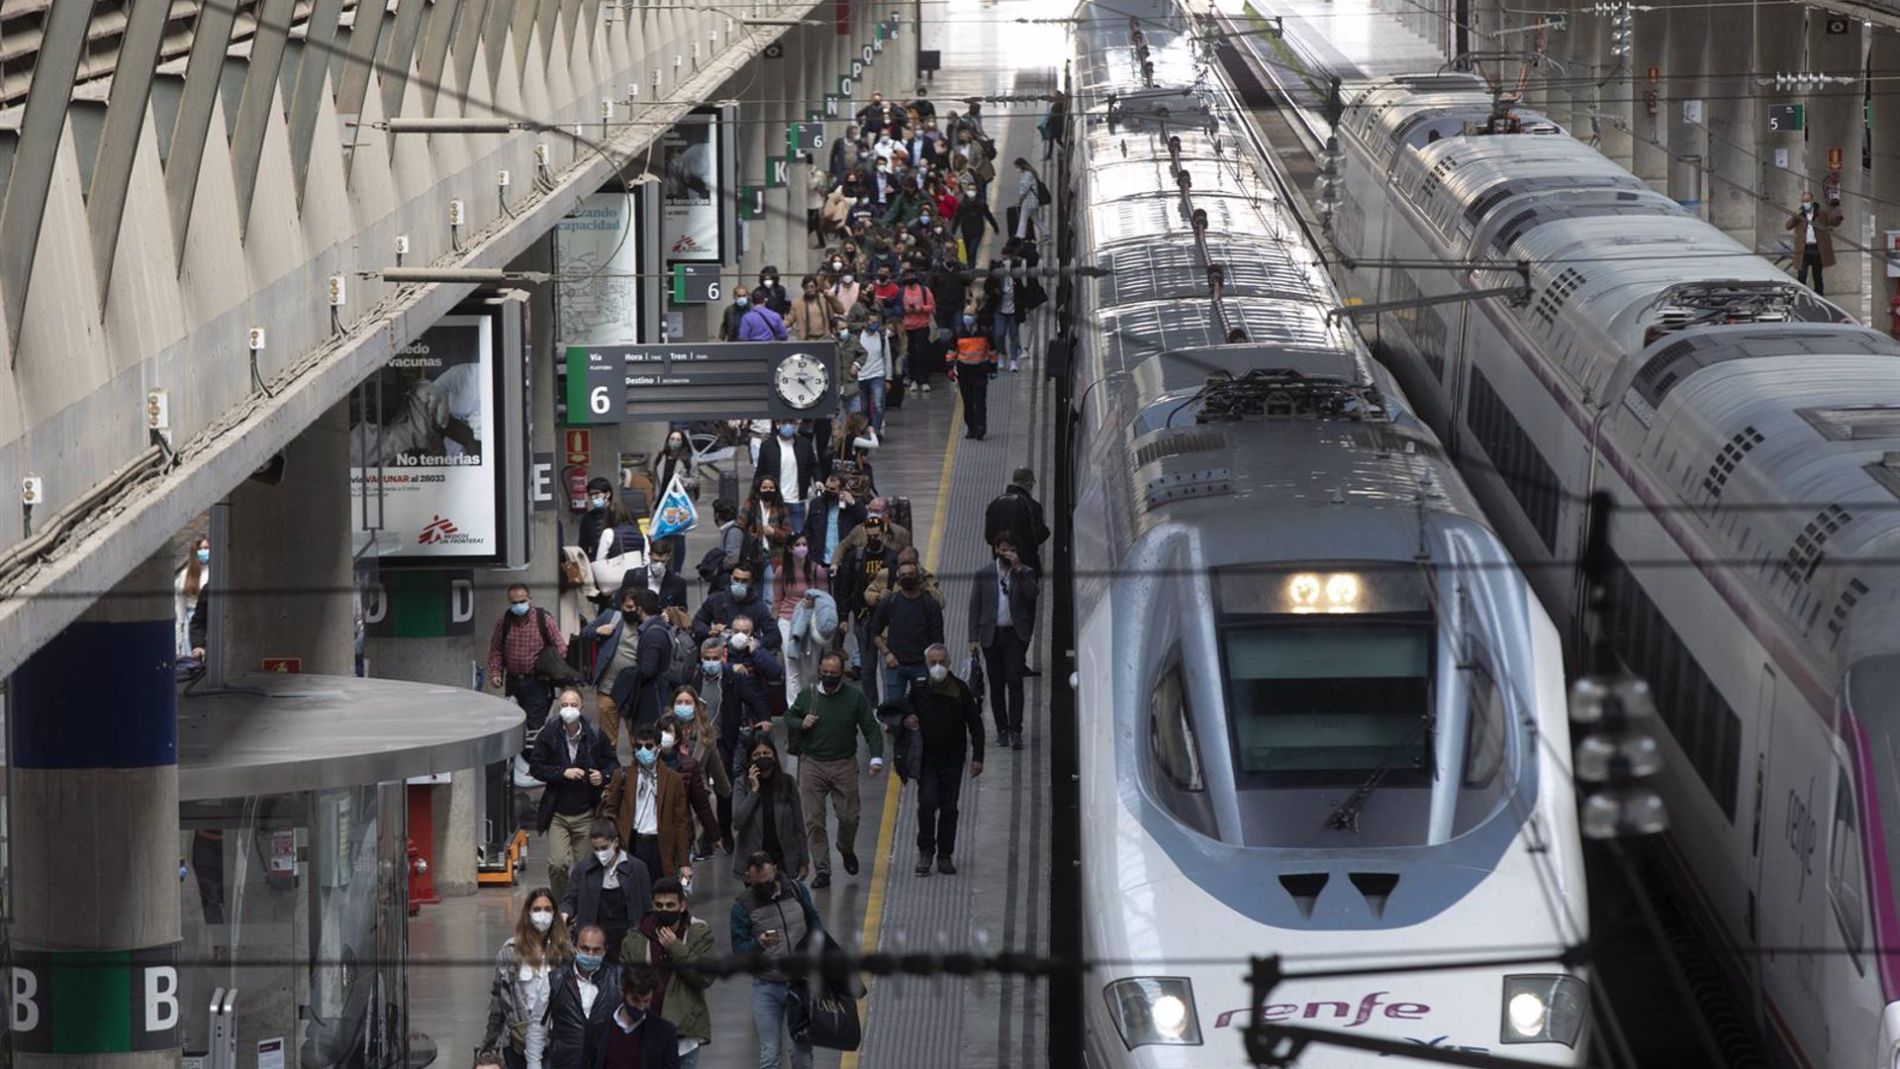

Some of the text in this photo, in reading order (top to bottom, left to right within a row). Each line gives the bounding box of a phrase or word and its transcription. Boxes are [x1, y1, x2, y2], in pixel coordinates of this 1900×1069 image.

[863, 46, 873, 65] Q
[852, 62, 862, 78] P
[842, 78, 851, 95] O
[827, 98, 838, 115] N
[1770, 117, 1778, 130] 5
[814, 135, 823, 148] 6
[774, 161, 787, 183] K
[753, 191, 763, 214] J
[708, 282, 720, 300] 6
[388, 358, 442, 367] vacunas
[625, 353, 643, 361] Hora
[670, 352, 687, 360] Tren
[625, 376, 654, 385] Destino
[590, 386, 611, 415] 6
[396, 452, 480, 466] No tenerlas
[365, 475, 410, 483] VAUNAR
[533, 463, 552, 501] E
[452, 579, 474, 623] D
[10, 966, 39, 1032] B
[144, 965, 179, 1032] B
[1214, 991, 1431, 1028] renfe
